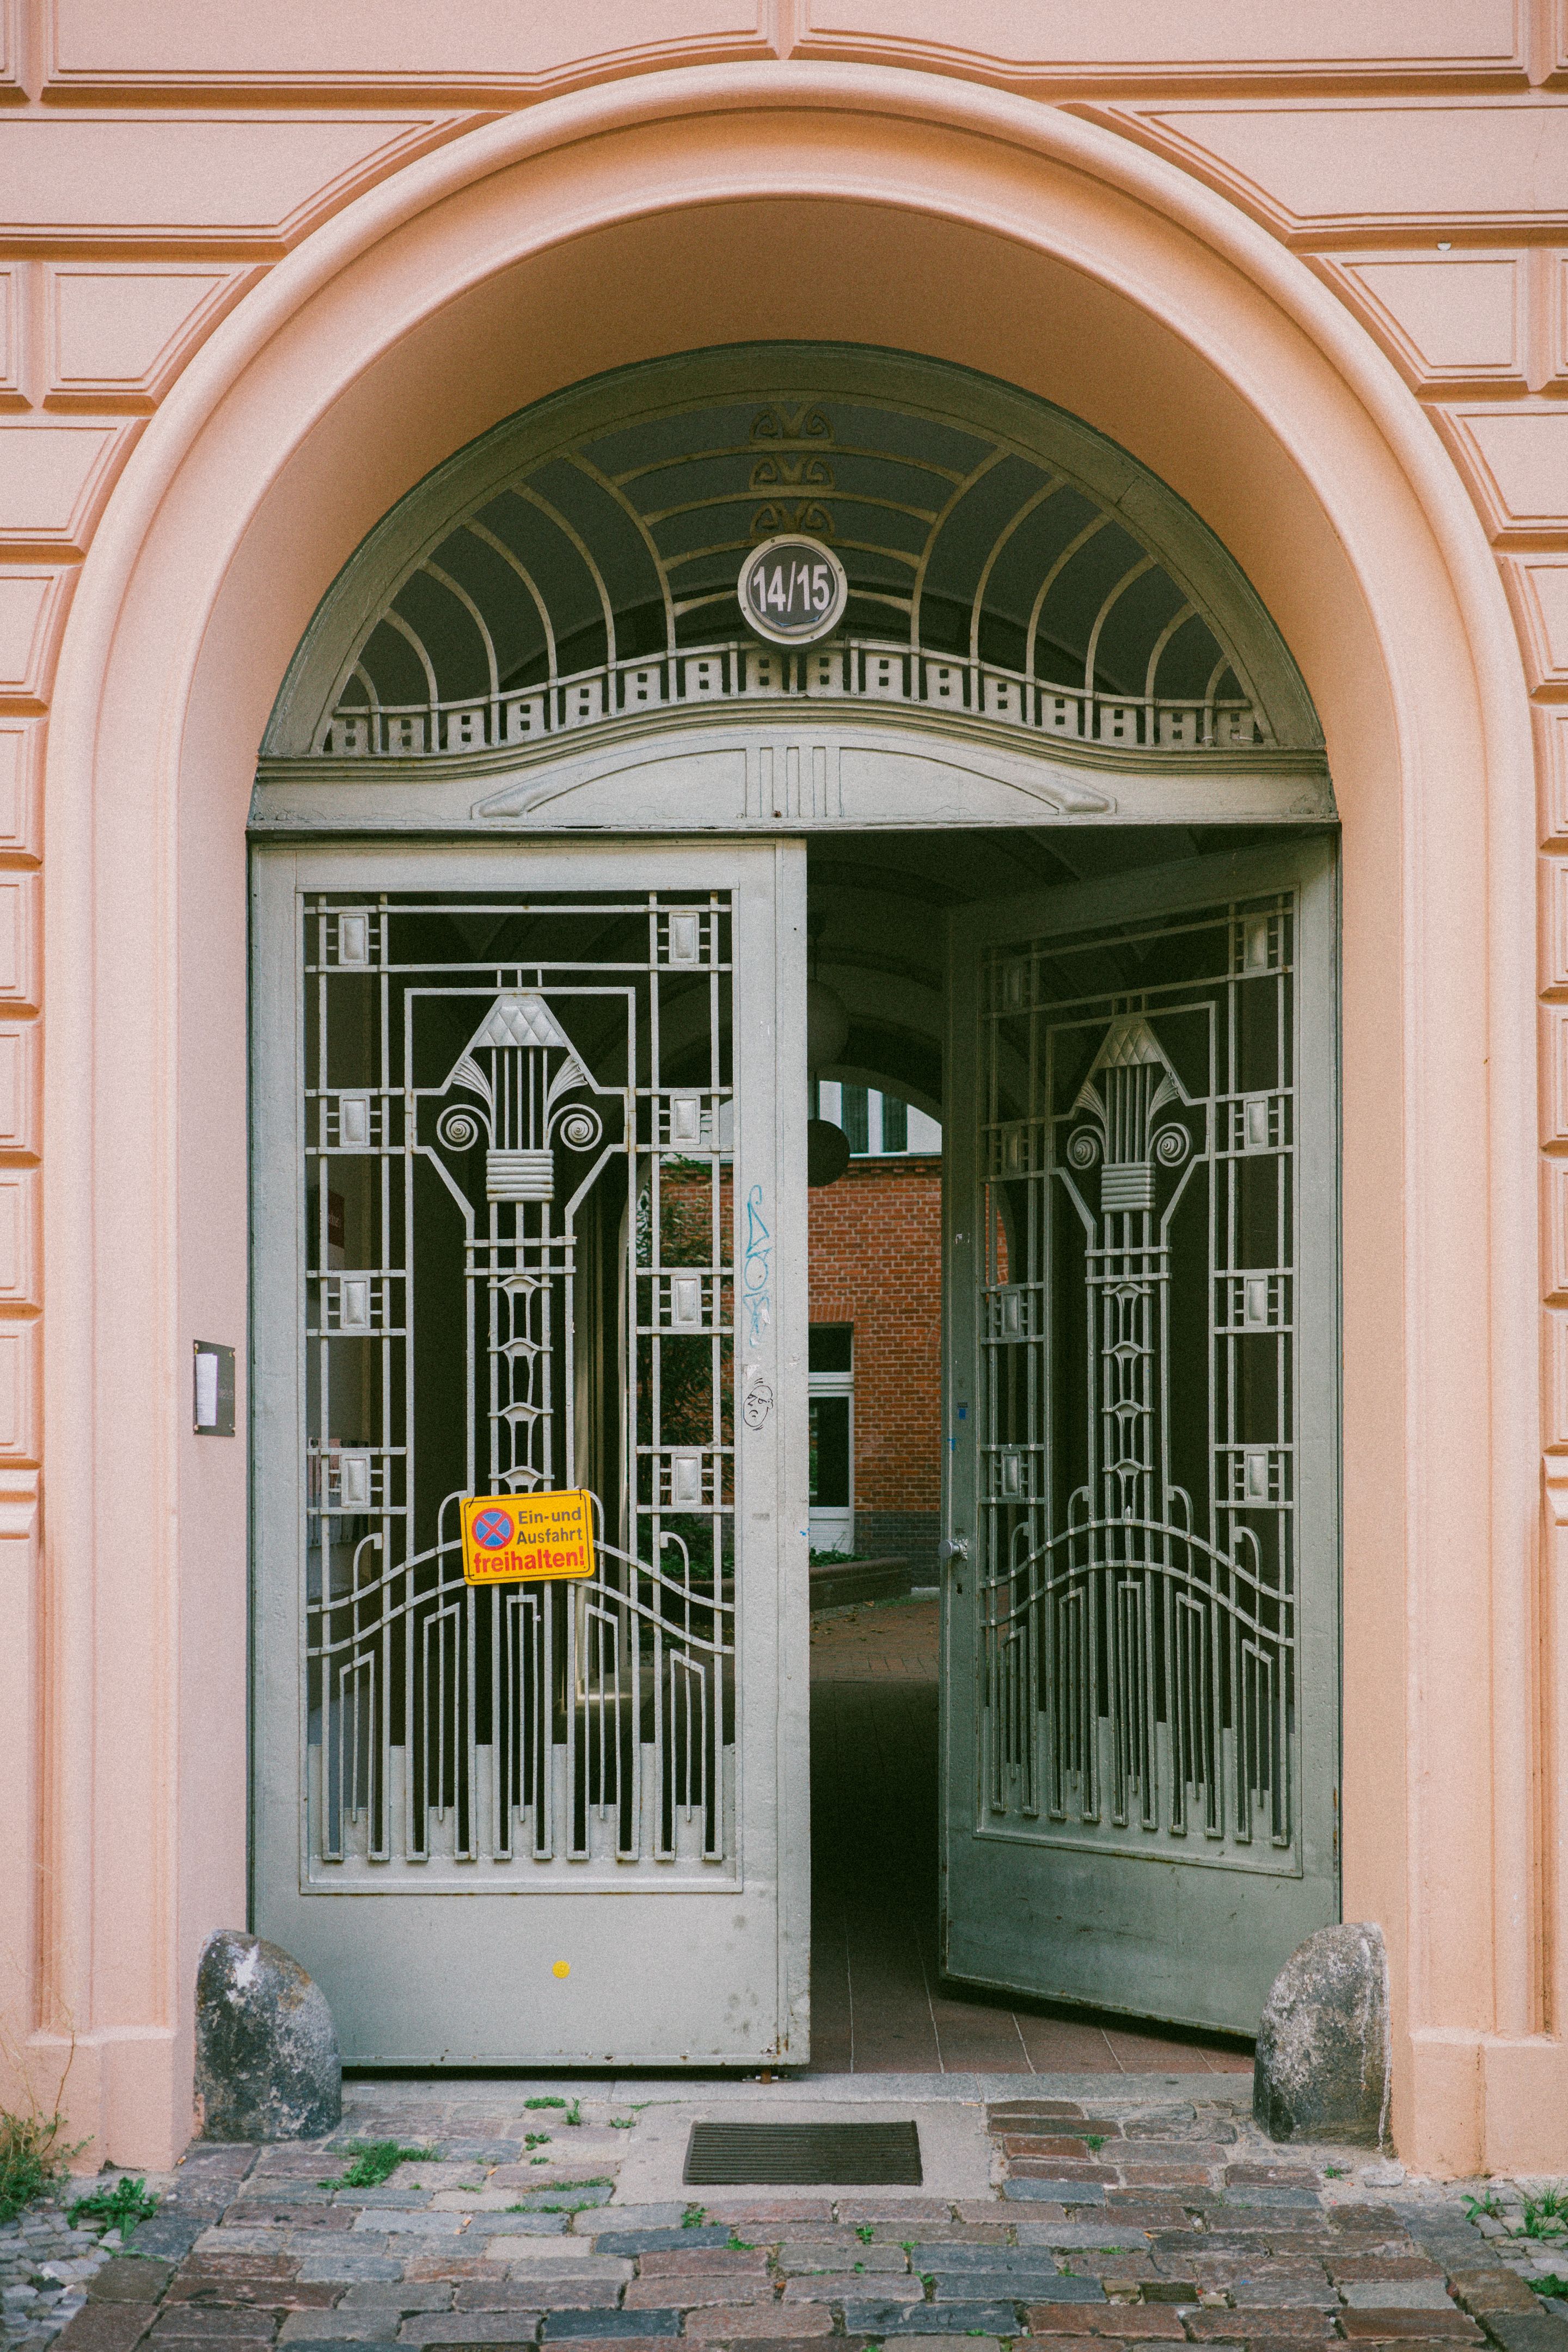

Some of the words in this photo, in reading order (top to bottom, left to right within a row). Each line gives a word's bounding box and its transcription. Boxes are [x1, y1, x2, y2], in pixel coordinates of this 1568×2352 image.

[754, 561, 830, 611] 14/15
[517, 1528, 582, 1545] Ausfahrt
[474, 1546, 584, 1573] freihalten!
